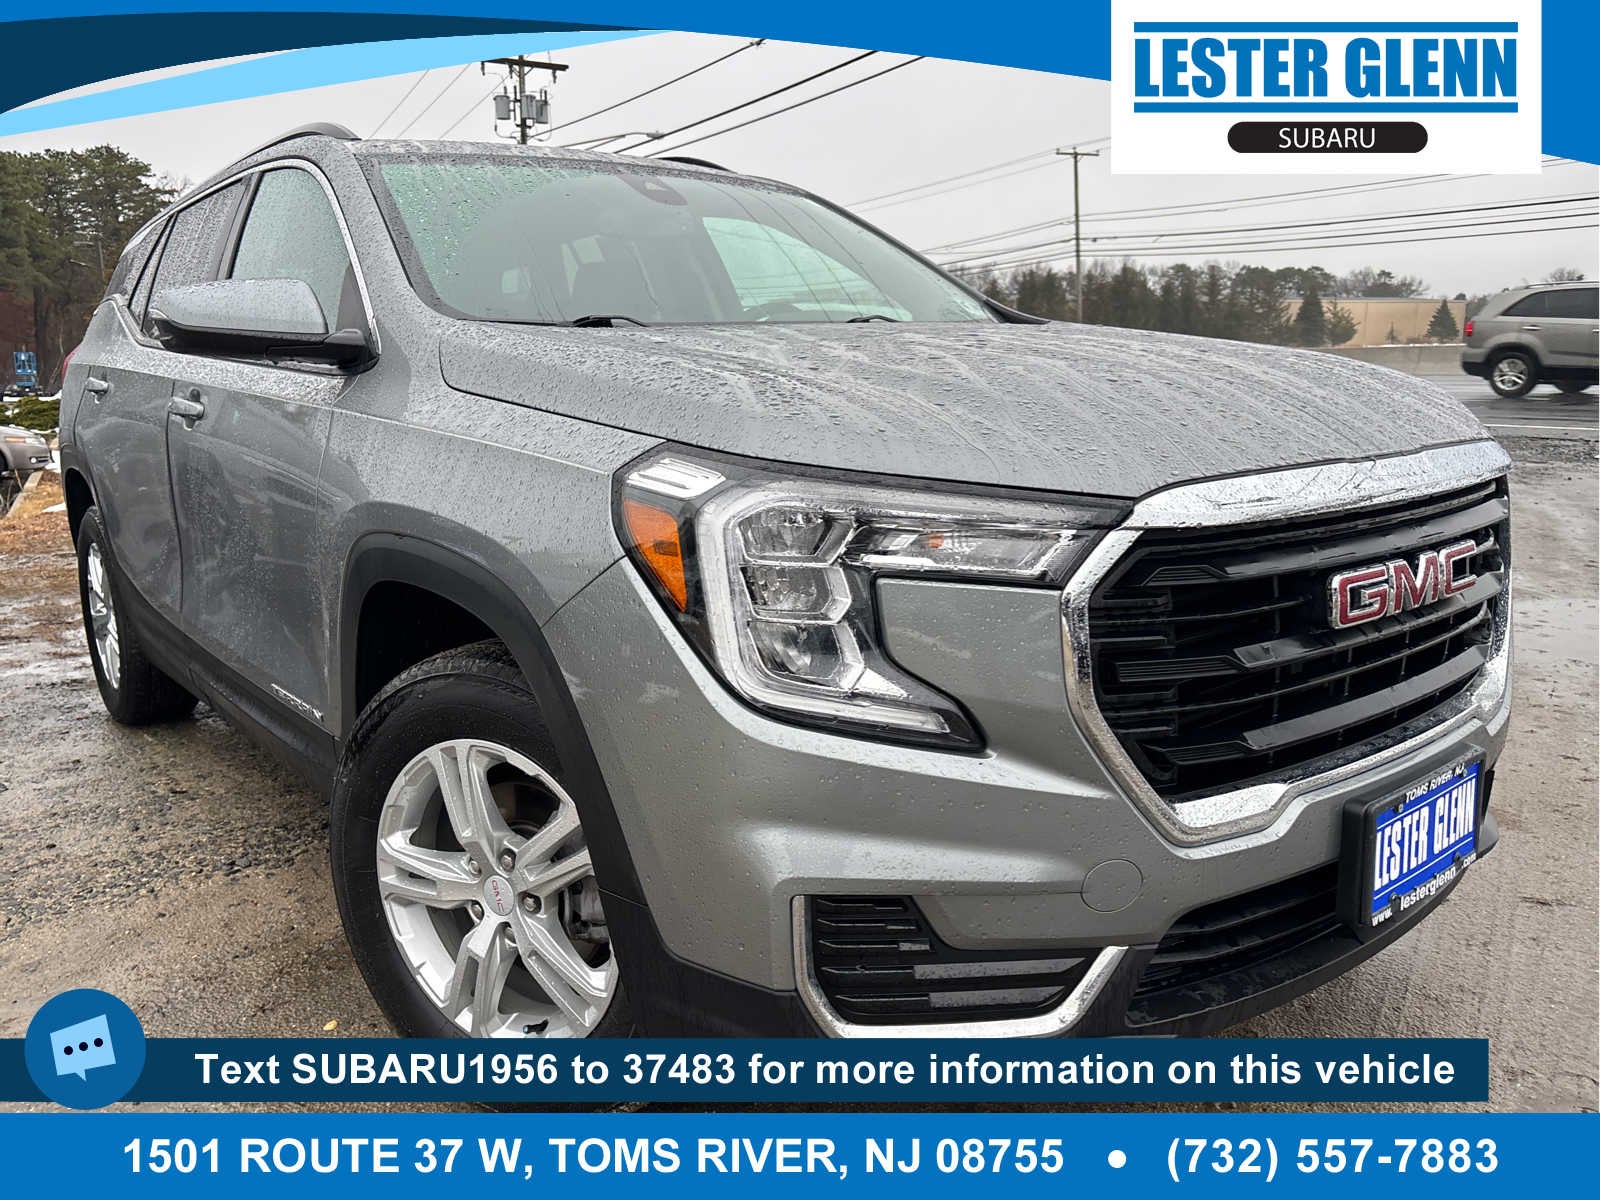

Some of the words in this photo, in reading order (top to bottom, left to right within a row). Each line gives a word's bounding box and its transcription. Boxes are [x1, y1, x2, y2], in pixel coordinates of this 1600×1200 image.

[1328, 540, 1477, 629] GMC
[1406, 782, 1430, 803] TOMS
[1454, 762, 1465, 777] NJ
[1374, 806, 1430, 891] LESTER
[1433, 777, 1476, 855] GLENN
[490, 879, 505, 913] GMC
